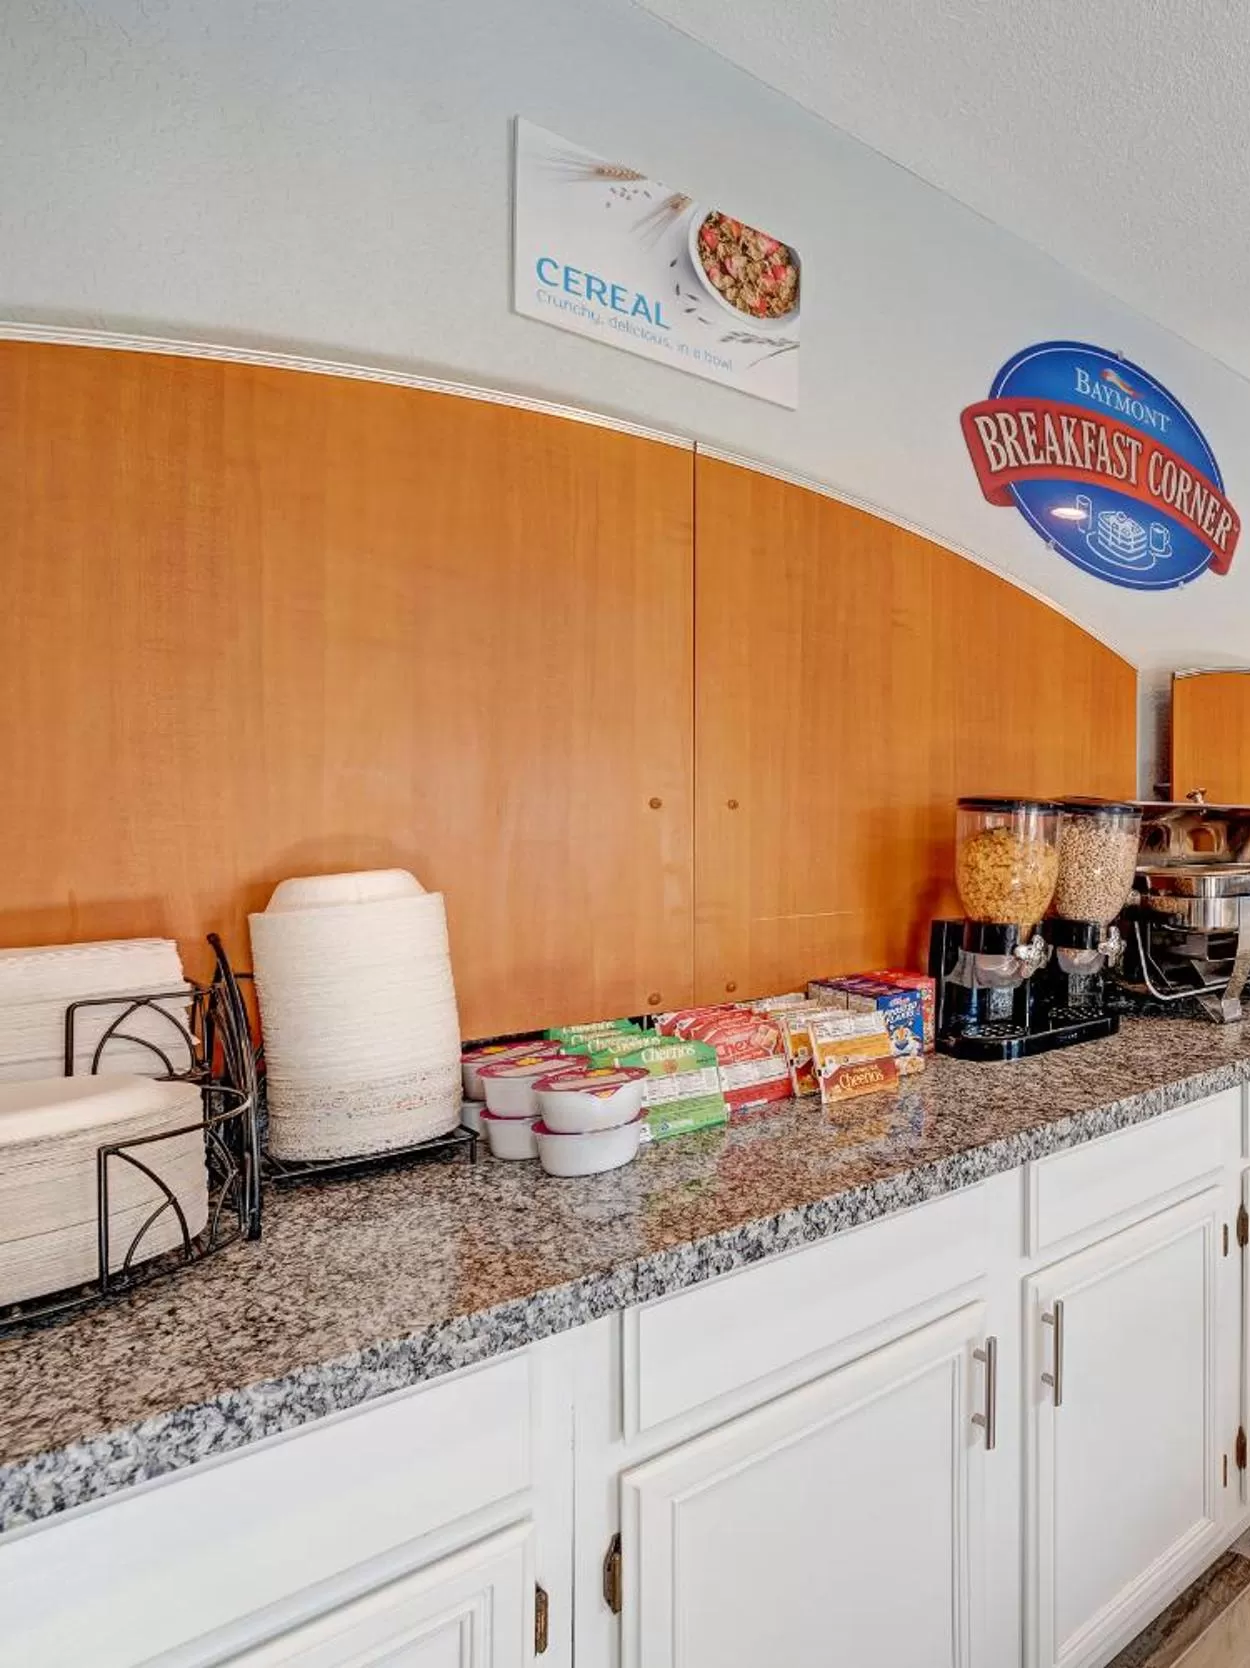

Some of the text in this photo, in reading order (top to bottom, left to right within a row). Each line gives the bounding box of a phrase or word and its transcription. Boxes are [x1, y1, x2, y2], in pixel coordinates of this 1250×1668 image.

[535, 256, 671, 330] CEREAL
[536, 288, 604, 326] Crunchy,
[609, 315, 674, 351] delicious,
[703, 350, 733, 371] bowl
[1074, 367, 1171, 433] BAYMONT
[973, 410, 1233, 552] BREAKFAST CORNER
